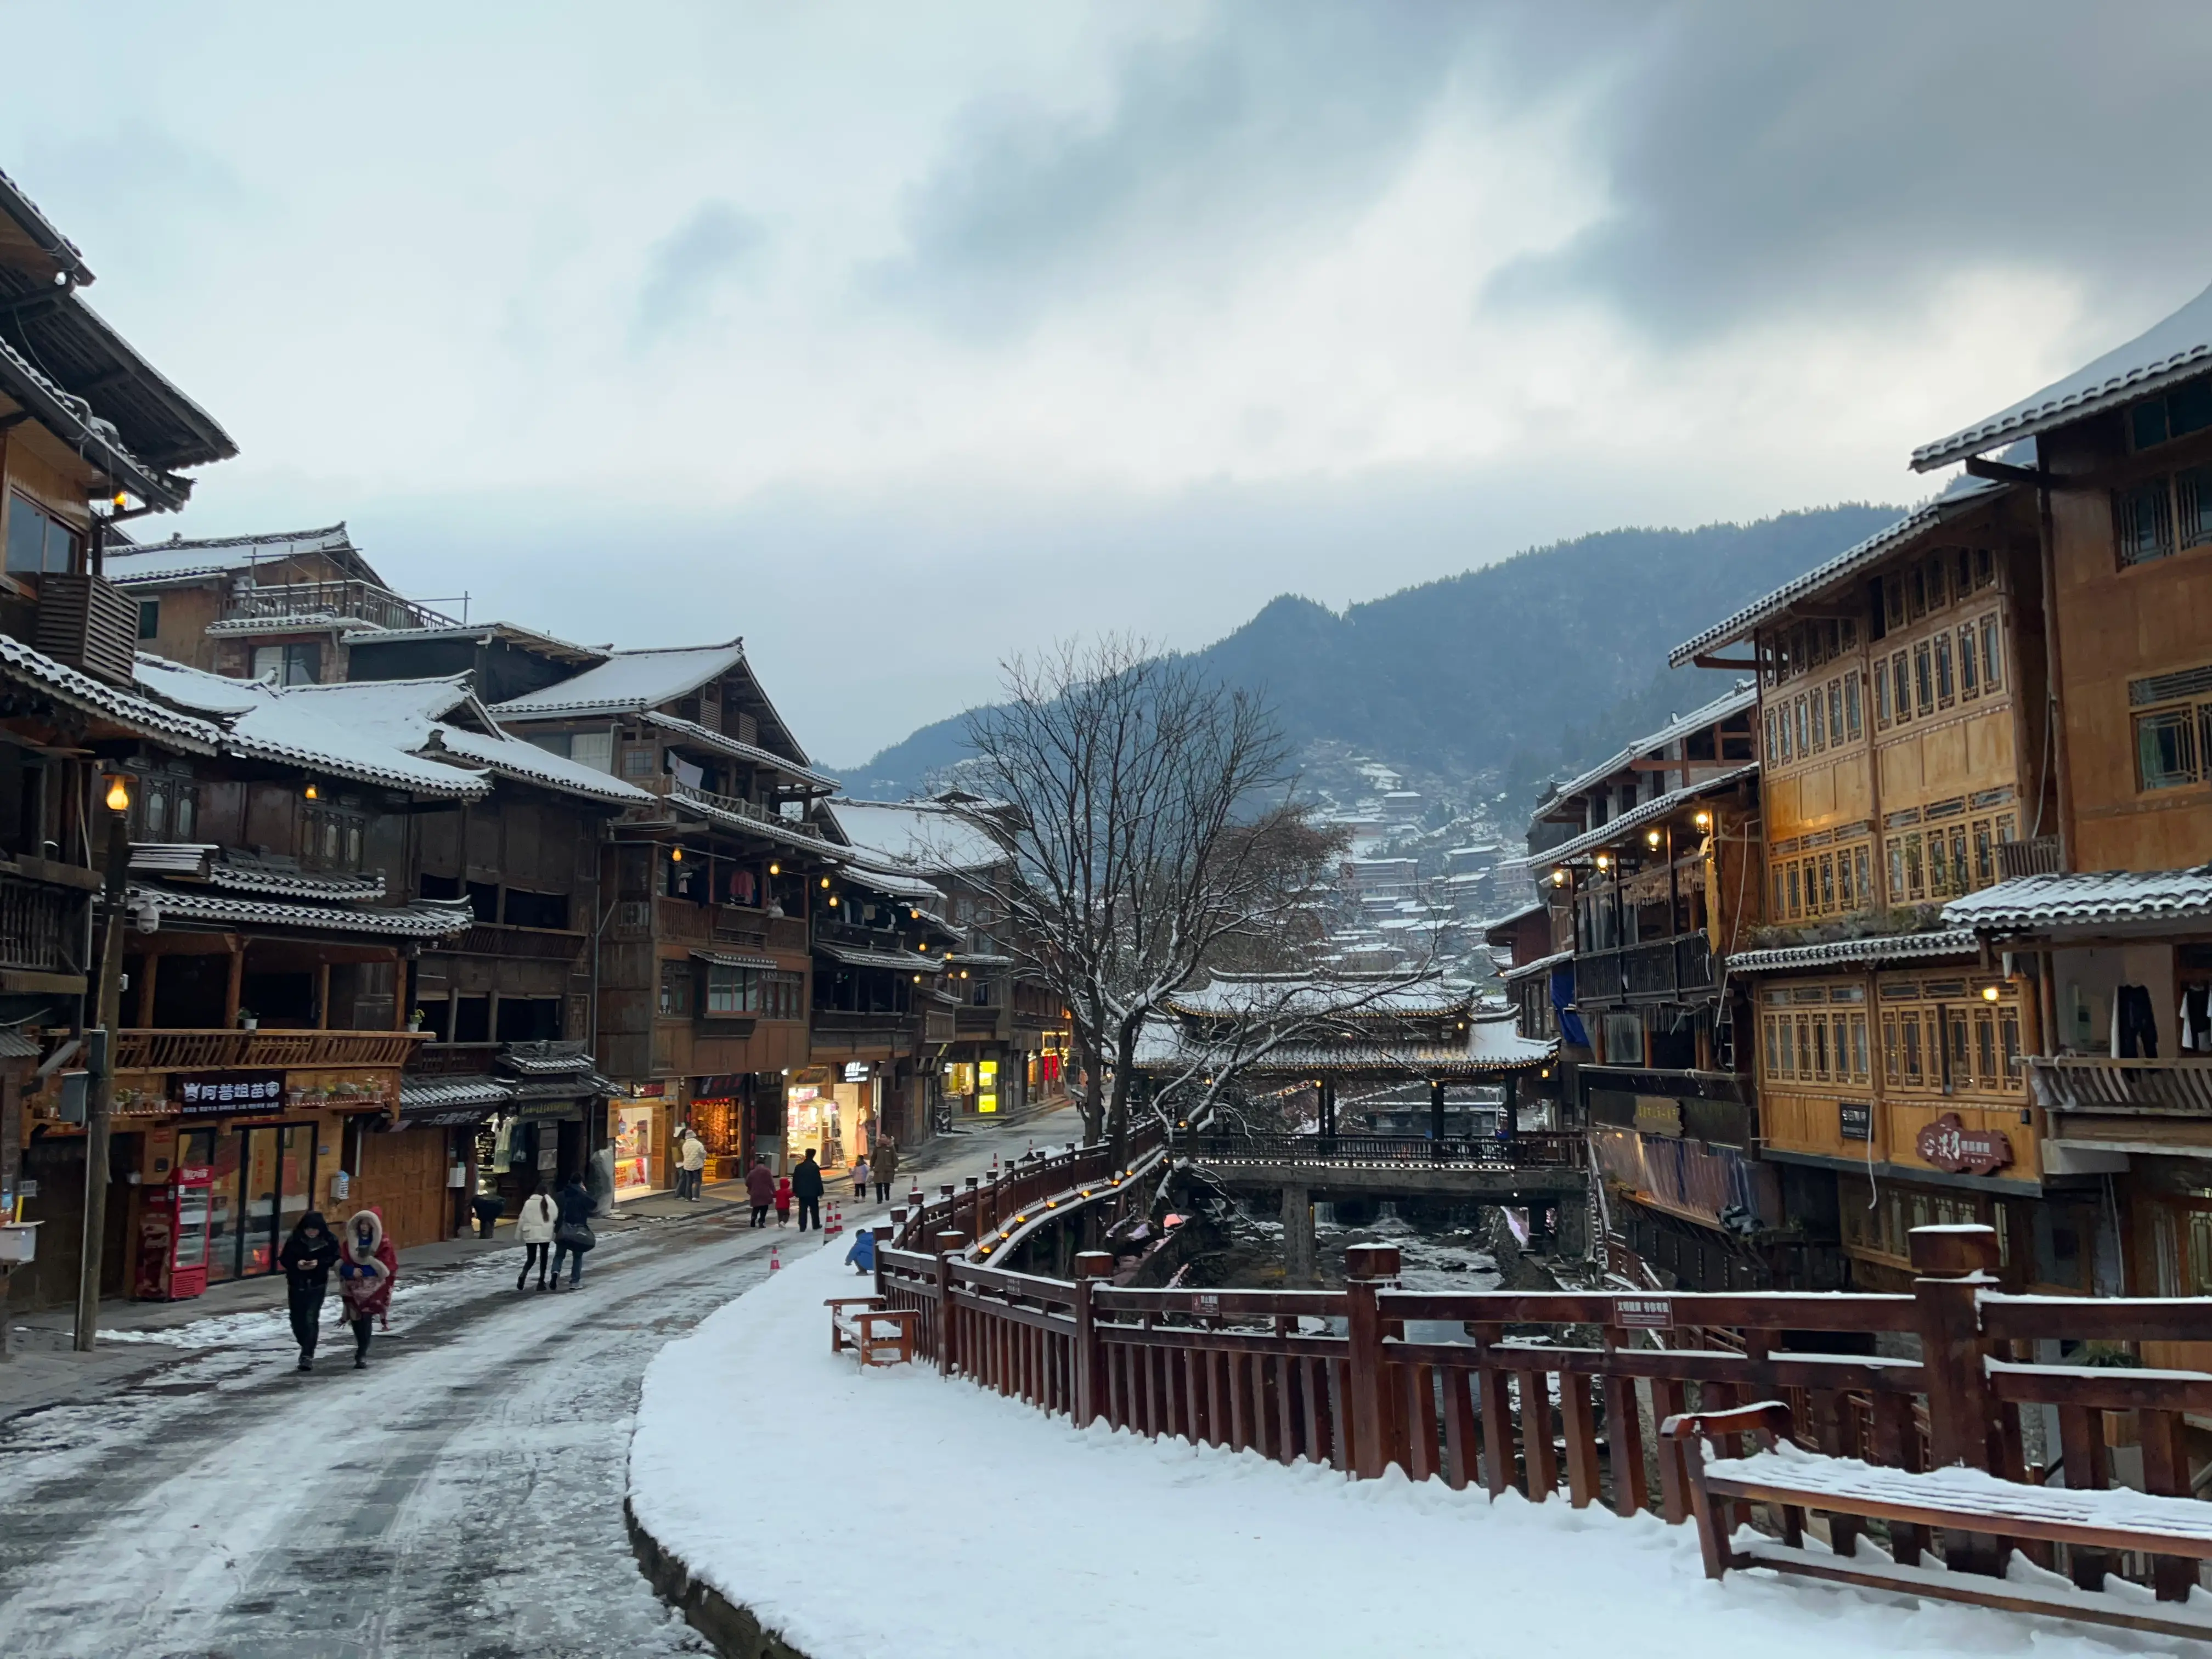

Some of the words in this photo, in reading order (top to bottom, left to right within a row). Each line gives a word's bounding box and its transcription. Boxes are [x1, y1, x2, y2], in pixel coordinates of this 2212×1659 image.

[202, 1081, 280, 1101] 阿普姐苗家
